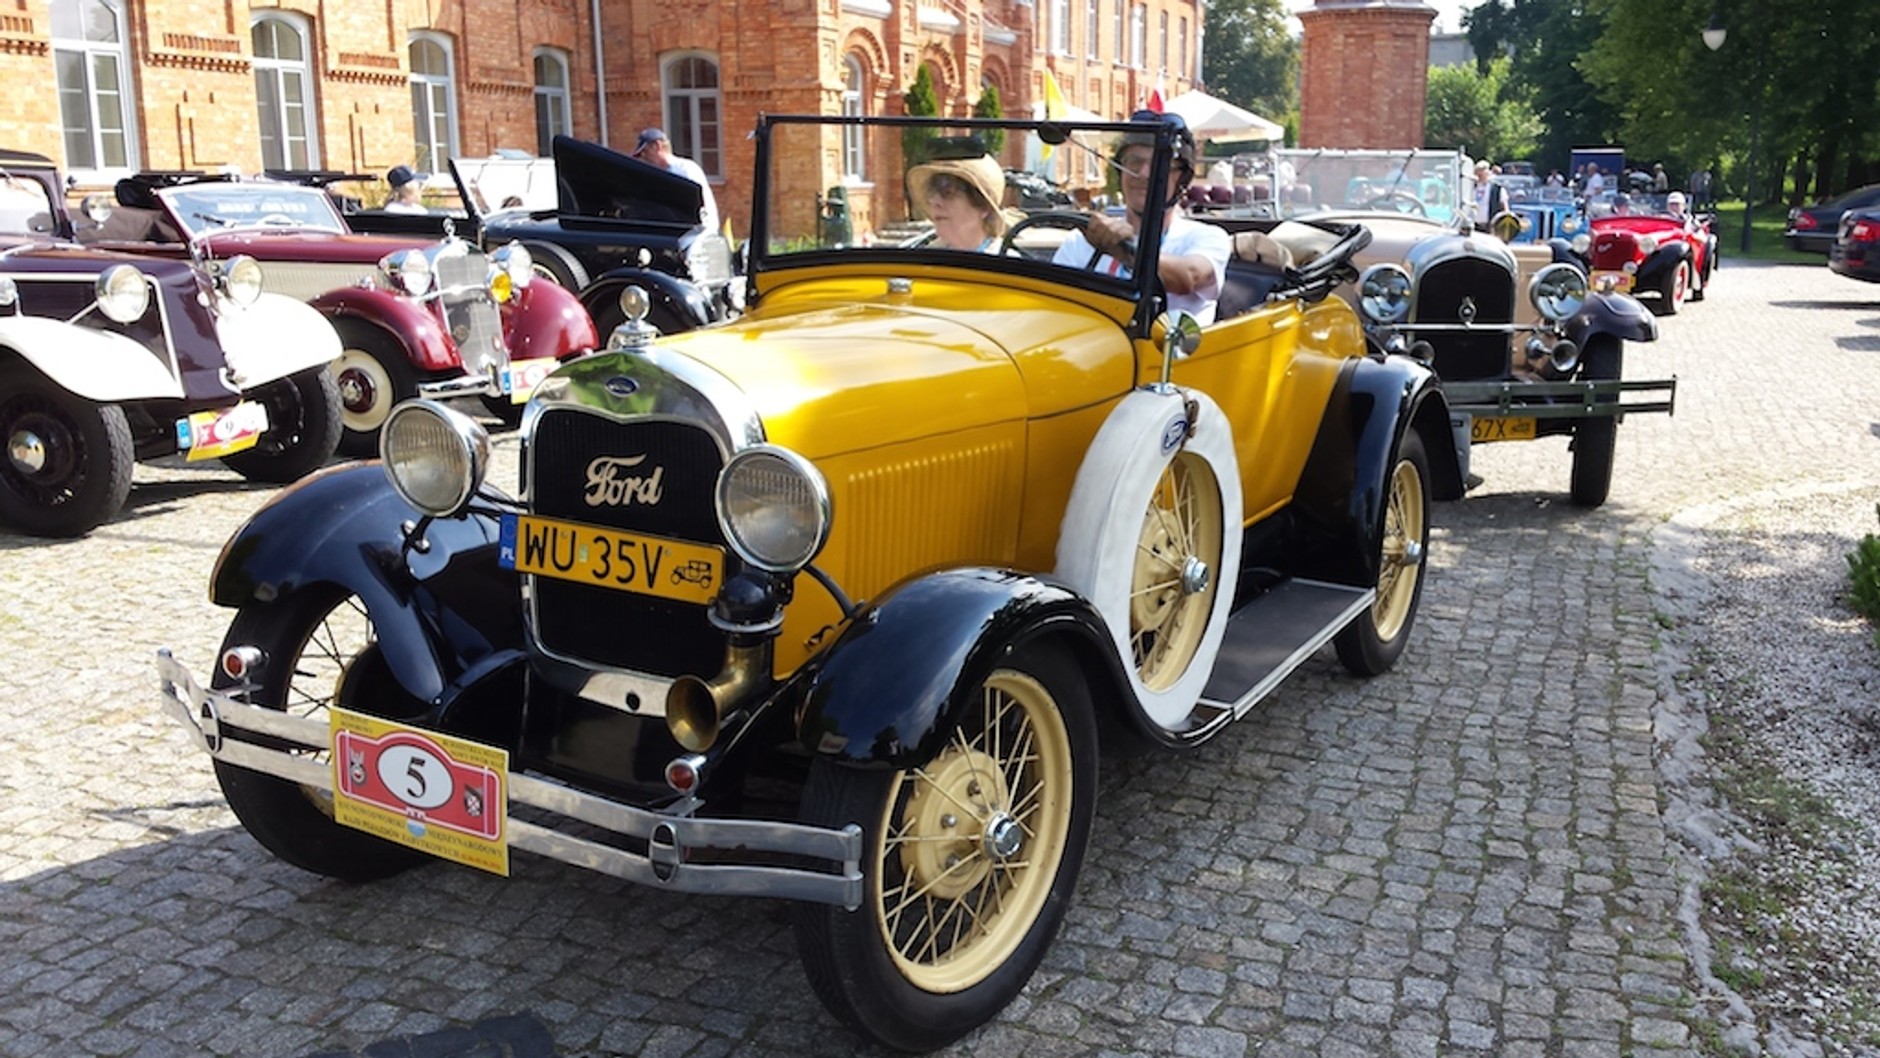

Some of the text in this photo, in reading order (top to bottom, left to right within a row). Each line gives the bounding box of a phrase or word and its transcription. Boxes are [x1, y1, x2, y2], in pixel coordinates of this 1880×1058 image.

[1471, 419, 1506, 438] 67X
[584, 453, 664, 507] Ford
[501, 546, 515, 561] PL
[525, 523, 663, 589] WU 35V
[407, 756, 426, 798] 5
